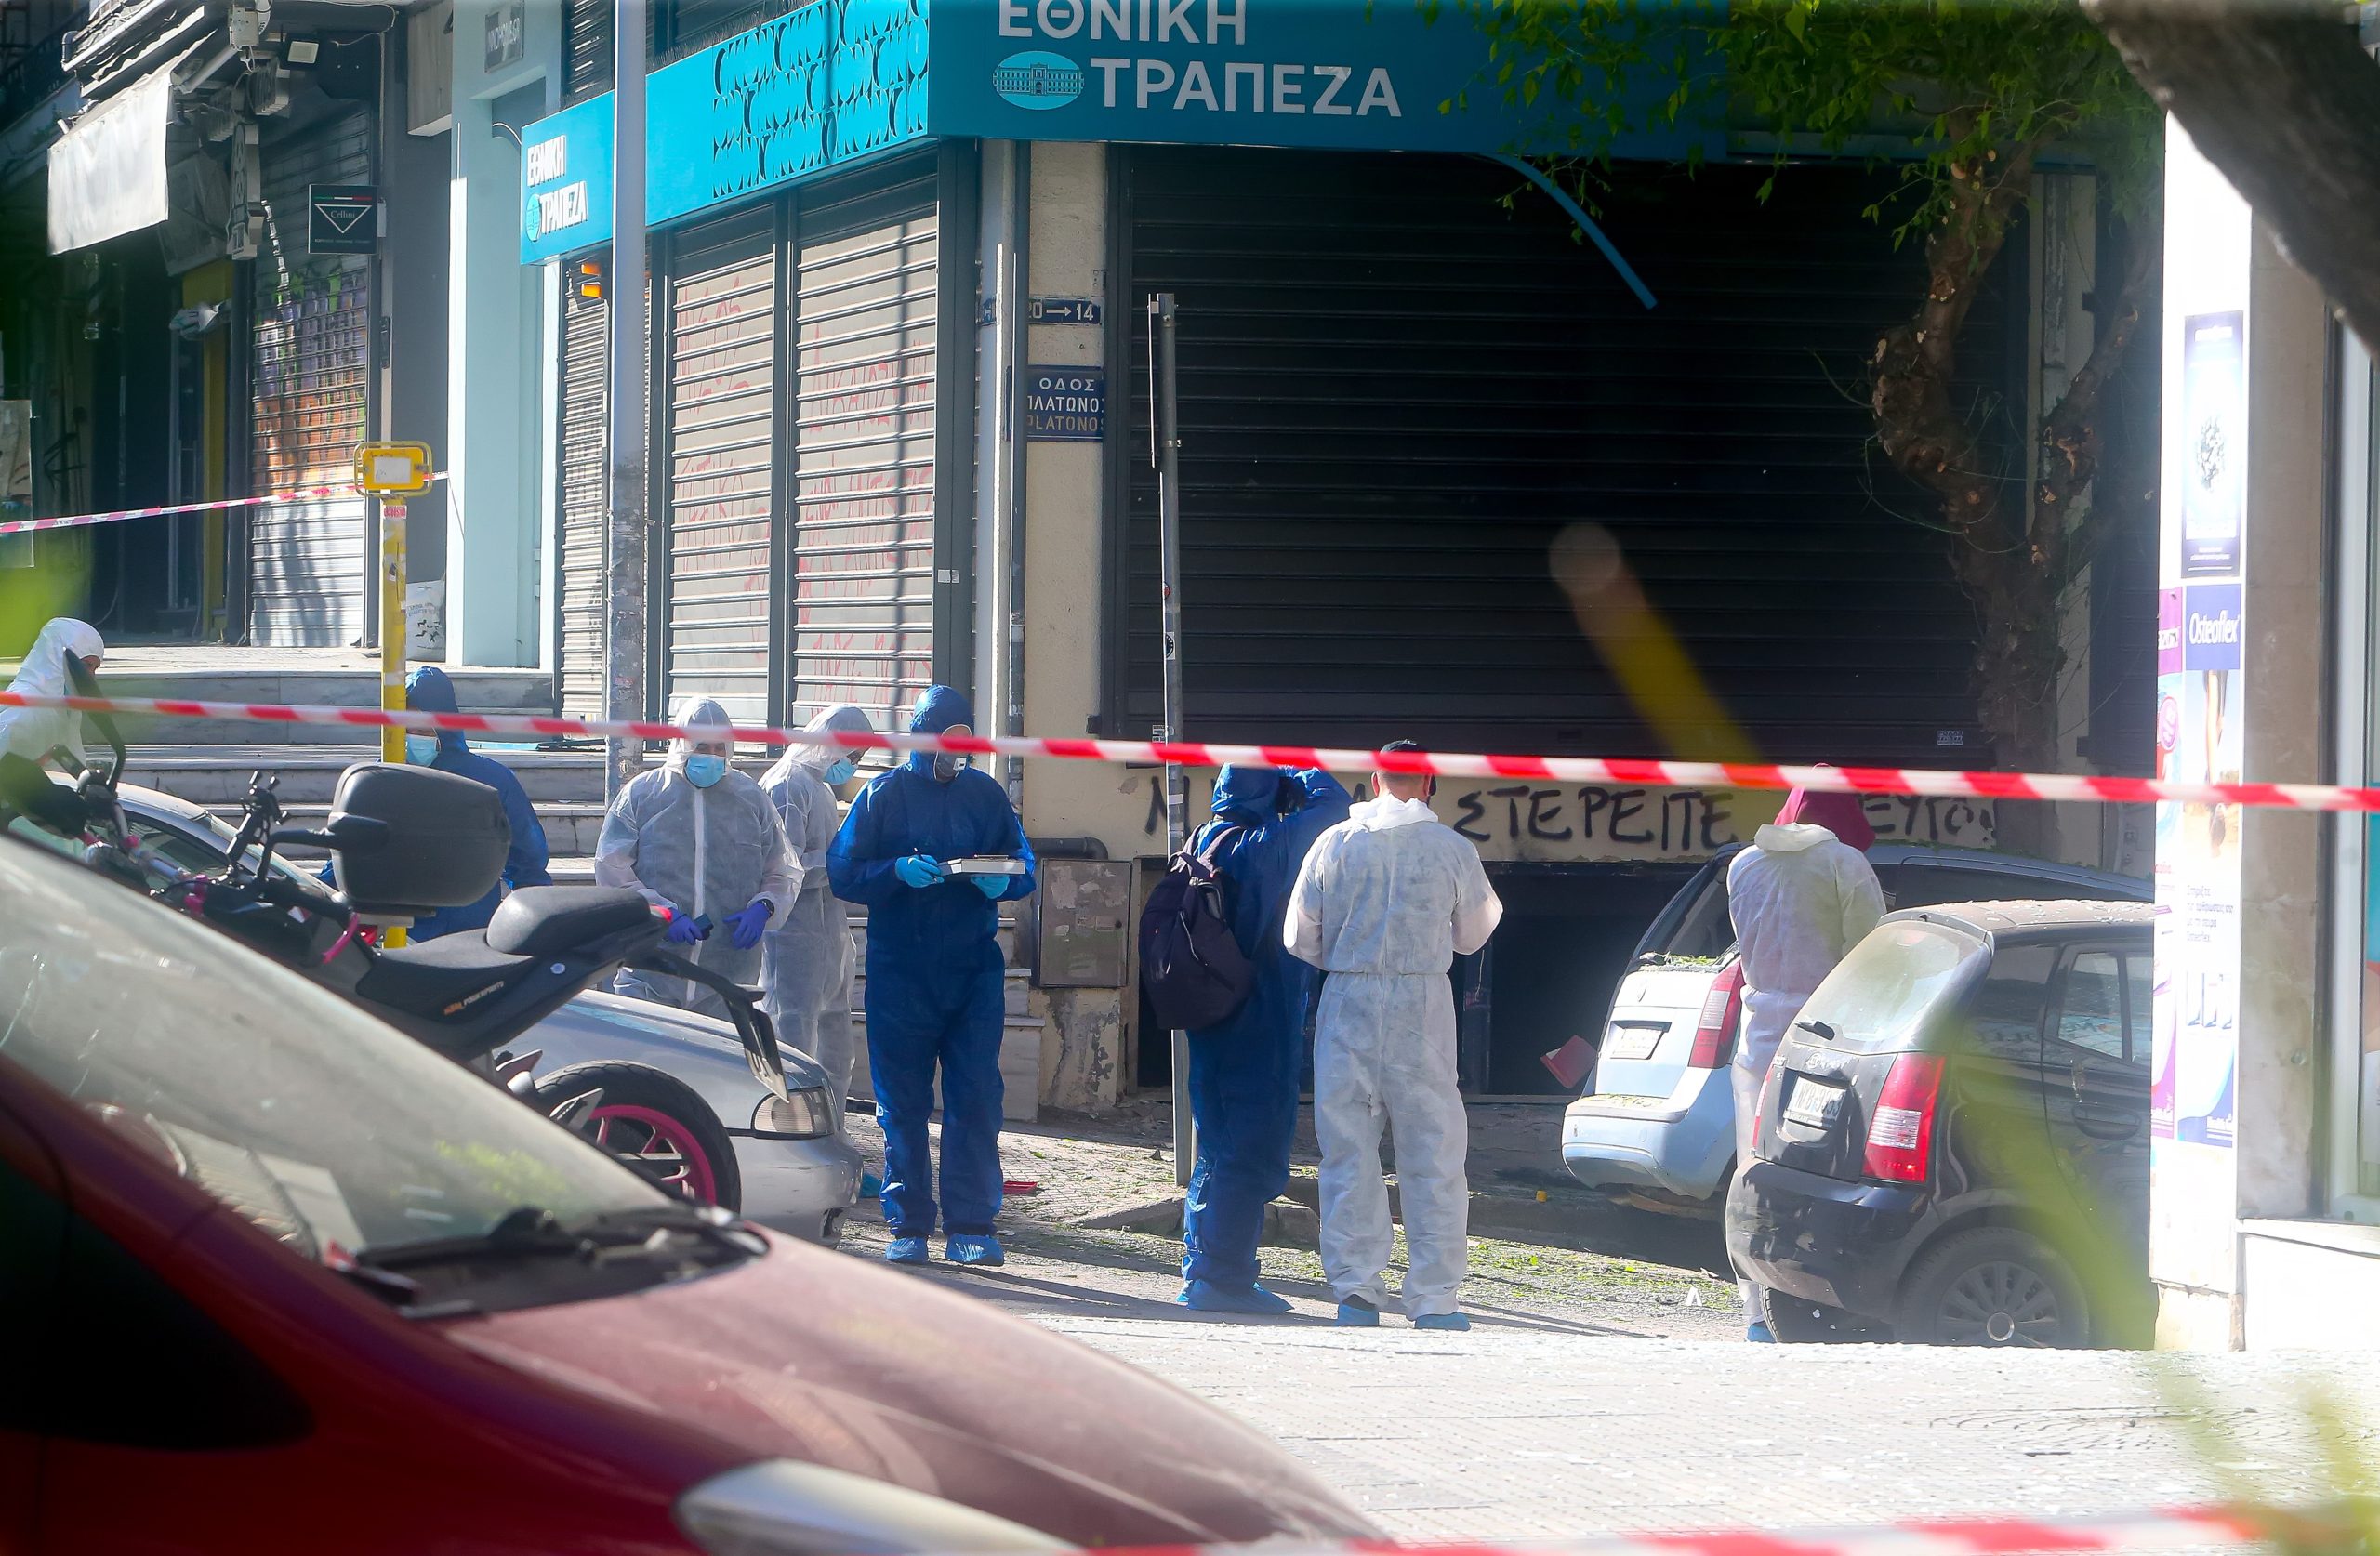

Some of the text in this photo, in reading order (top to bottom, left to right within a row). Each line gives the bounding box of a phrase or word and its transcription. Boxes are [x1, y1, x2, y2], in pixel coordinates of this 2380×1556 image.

[998, 0, 1247, 46] ΕΘΝΙΚΗ
[1090, 57, 1402, 117] ΤΡΑΠΕΖΑ
[527, 135, 566, 187] ΕΘΝΙΚΗ
[330, 210, 355, 219] Cellini
[539, 180, 588, 234] ΤΡΑΠΕΖΑ
[1076, 303, 1094, 321] 14
[1027, 395, 1104, 414] ΠΛΑΤΩΝΟ
[1038, 377, 1095, 391] ΟΔΟΣ
[2188, 609, 2239, 645] Osteoflex
[1453, 785, 1737, 851] ΣΤΕΡΕΙΤΕ
